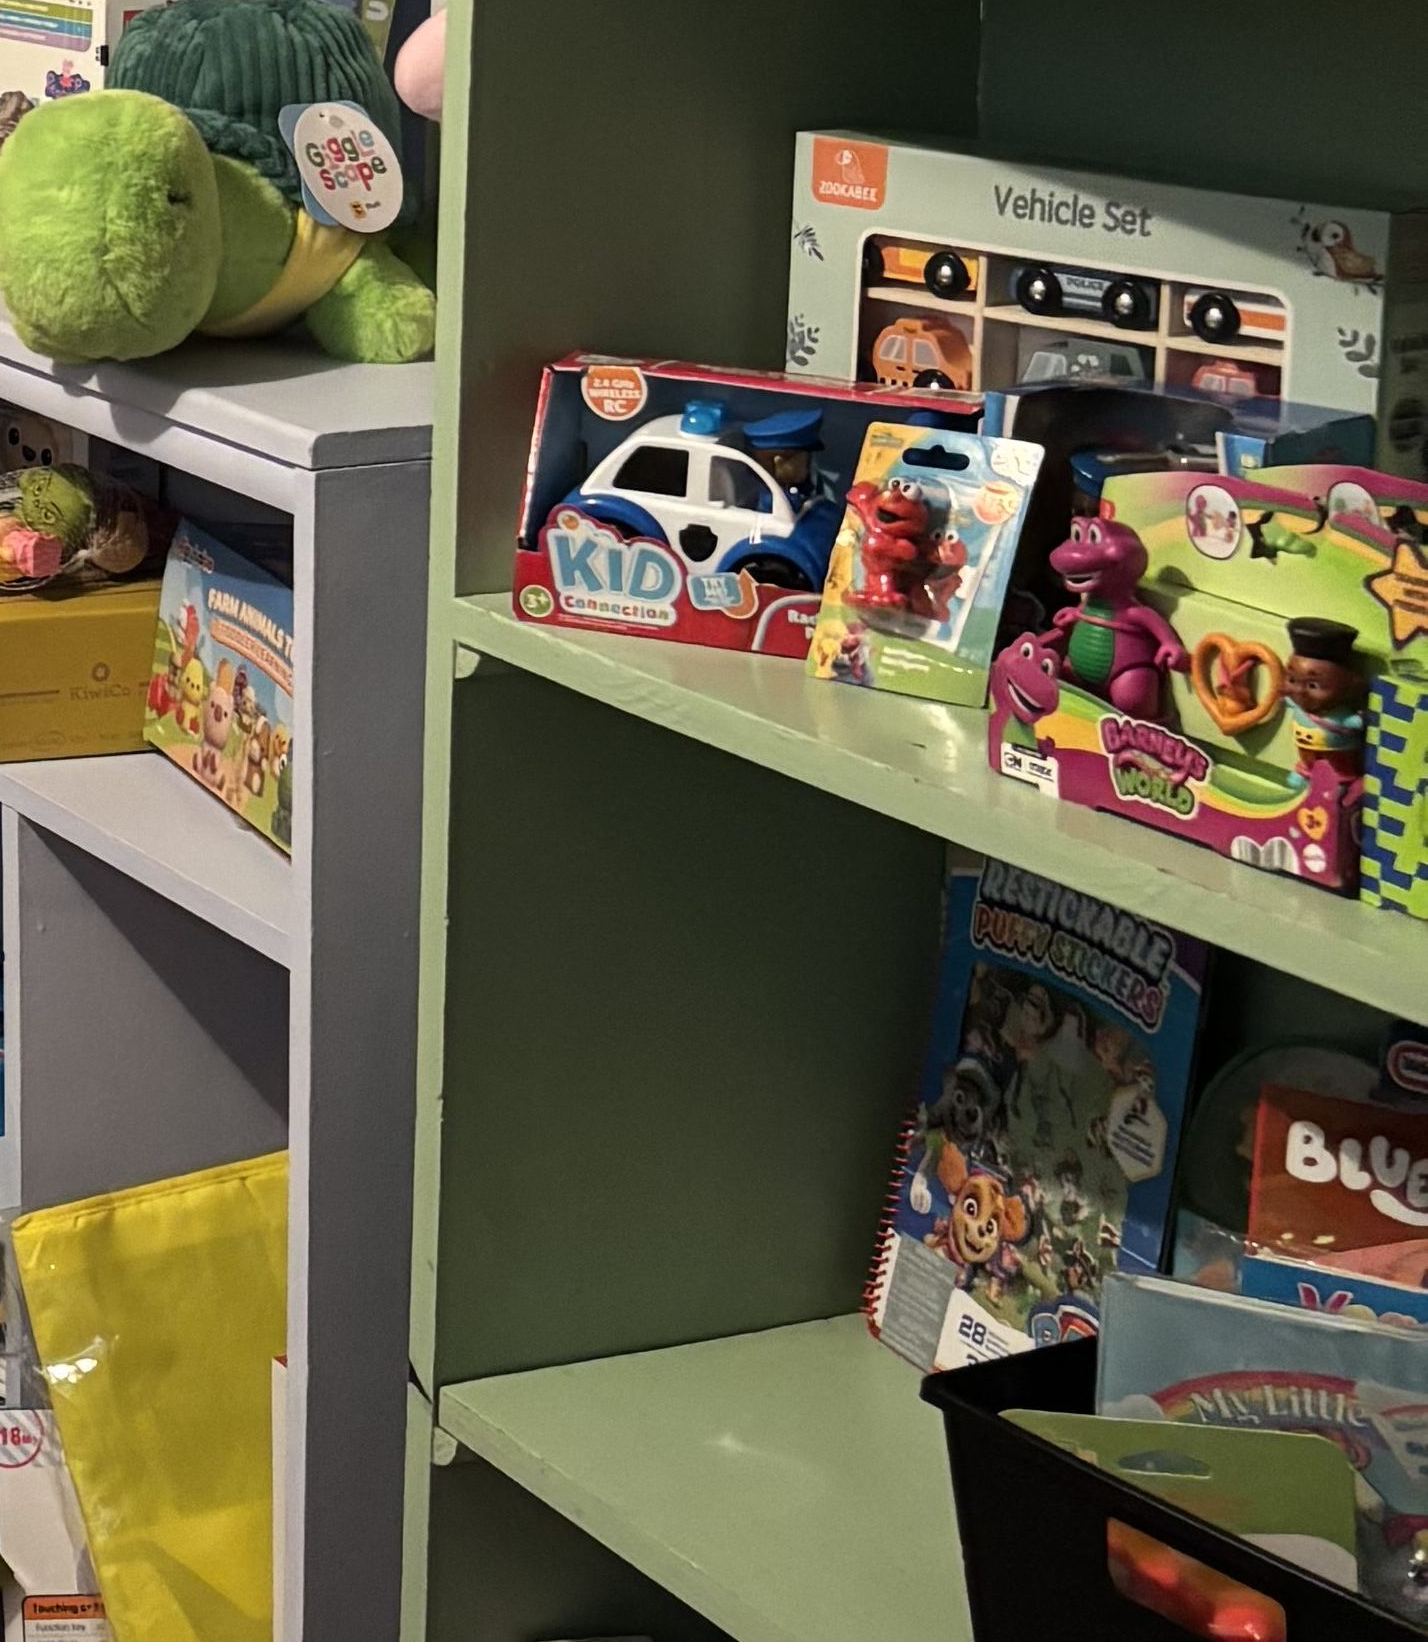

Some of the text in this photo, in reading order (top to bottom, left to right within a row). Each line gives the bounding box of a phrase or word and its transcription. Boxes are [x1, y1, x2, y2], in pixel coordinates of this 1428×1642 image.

[818, 180, 878, 202] ZOOKABEE
[993, 184, 1152, 238] Vehicle Set
[1066, 277, 1104, 291] POLICE
[603, 399, 626, 415] RC
[552, 532, 677, 606] KID
[207, 587, 240, 619] FARM
[562, 595, 671, 622] Connection
[1116, 765, 1196, 815] WORLD
[1049, 931, 1163, 1024] STICKERS
[958, 1313, 988, 1345] 28
[1189, 1384, 1370, 1427] My Little
